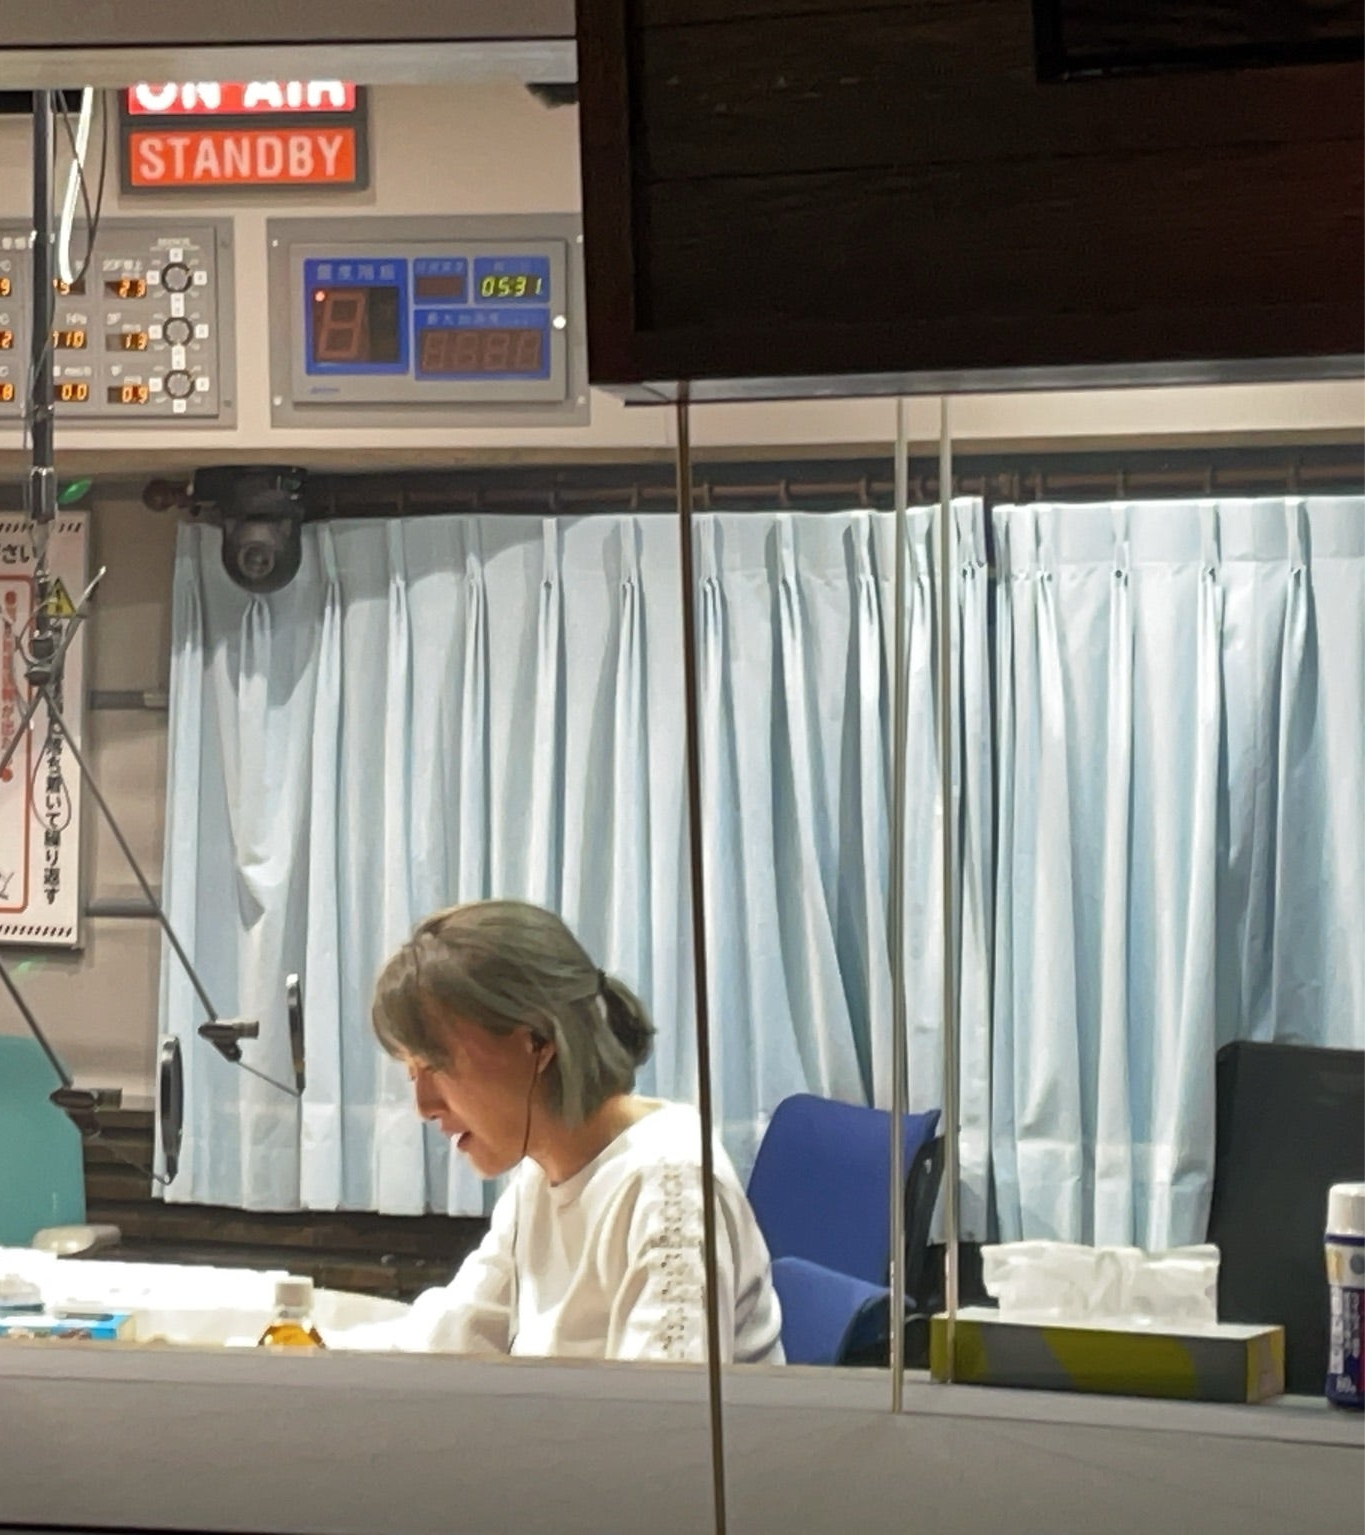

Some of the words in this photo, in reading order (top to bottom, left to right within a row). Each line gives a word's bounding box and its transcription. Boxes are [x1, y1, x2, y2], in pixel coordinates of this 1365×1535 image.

[134, 80, 221, 110] ON
[243, 80, 346, 109] AIR
[139, 135, 343, 181] STANDBY
